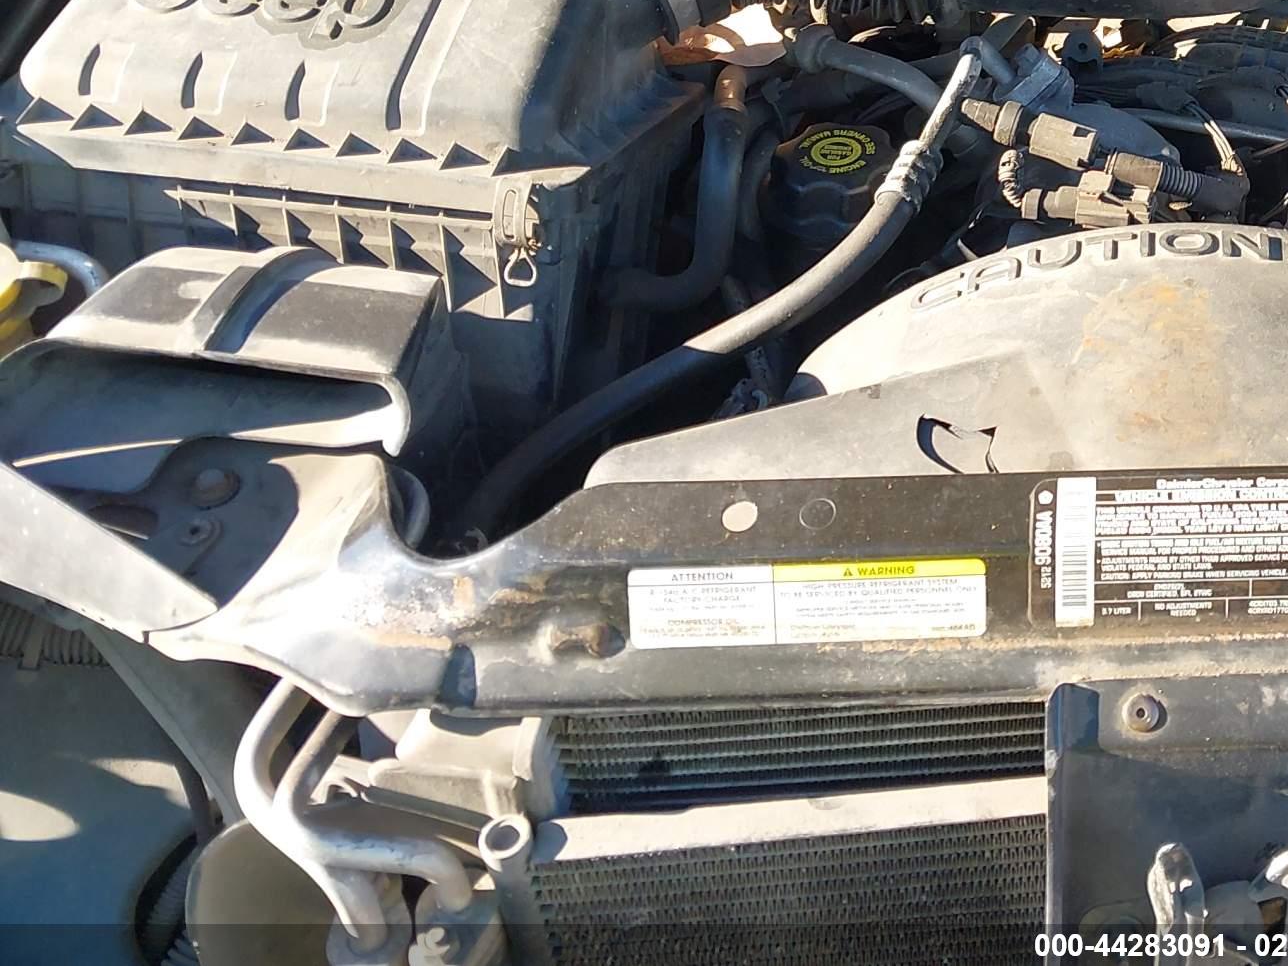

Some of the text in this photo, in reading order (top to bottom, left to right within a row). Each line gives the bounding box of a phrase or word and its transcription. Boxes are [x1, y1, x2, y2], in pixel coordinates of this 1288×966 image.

[911, 231, 1285, 312] CAUTION
[857, 566, 915, 576] WARNING
[671, 571, 734, 582] ATTENTION
[869, 580, 924, 588] REFRIGERANT
[926, 578, 958, 586] SYSTEM
[861, 588, 903, 596] QUALIFIED
[1166, 601, 1212, 609] ADJUSTMENTS
[667, 618, 723, 626] COMPRESSOR
